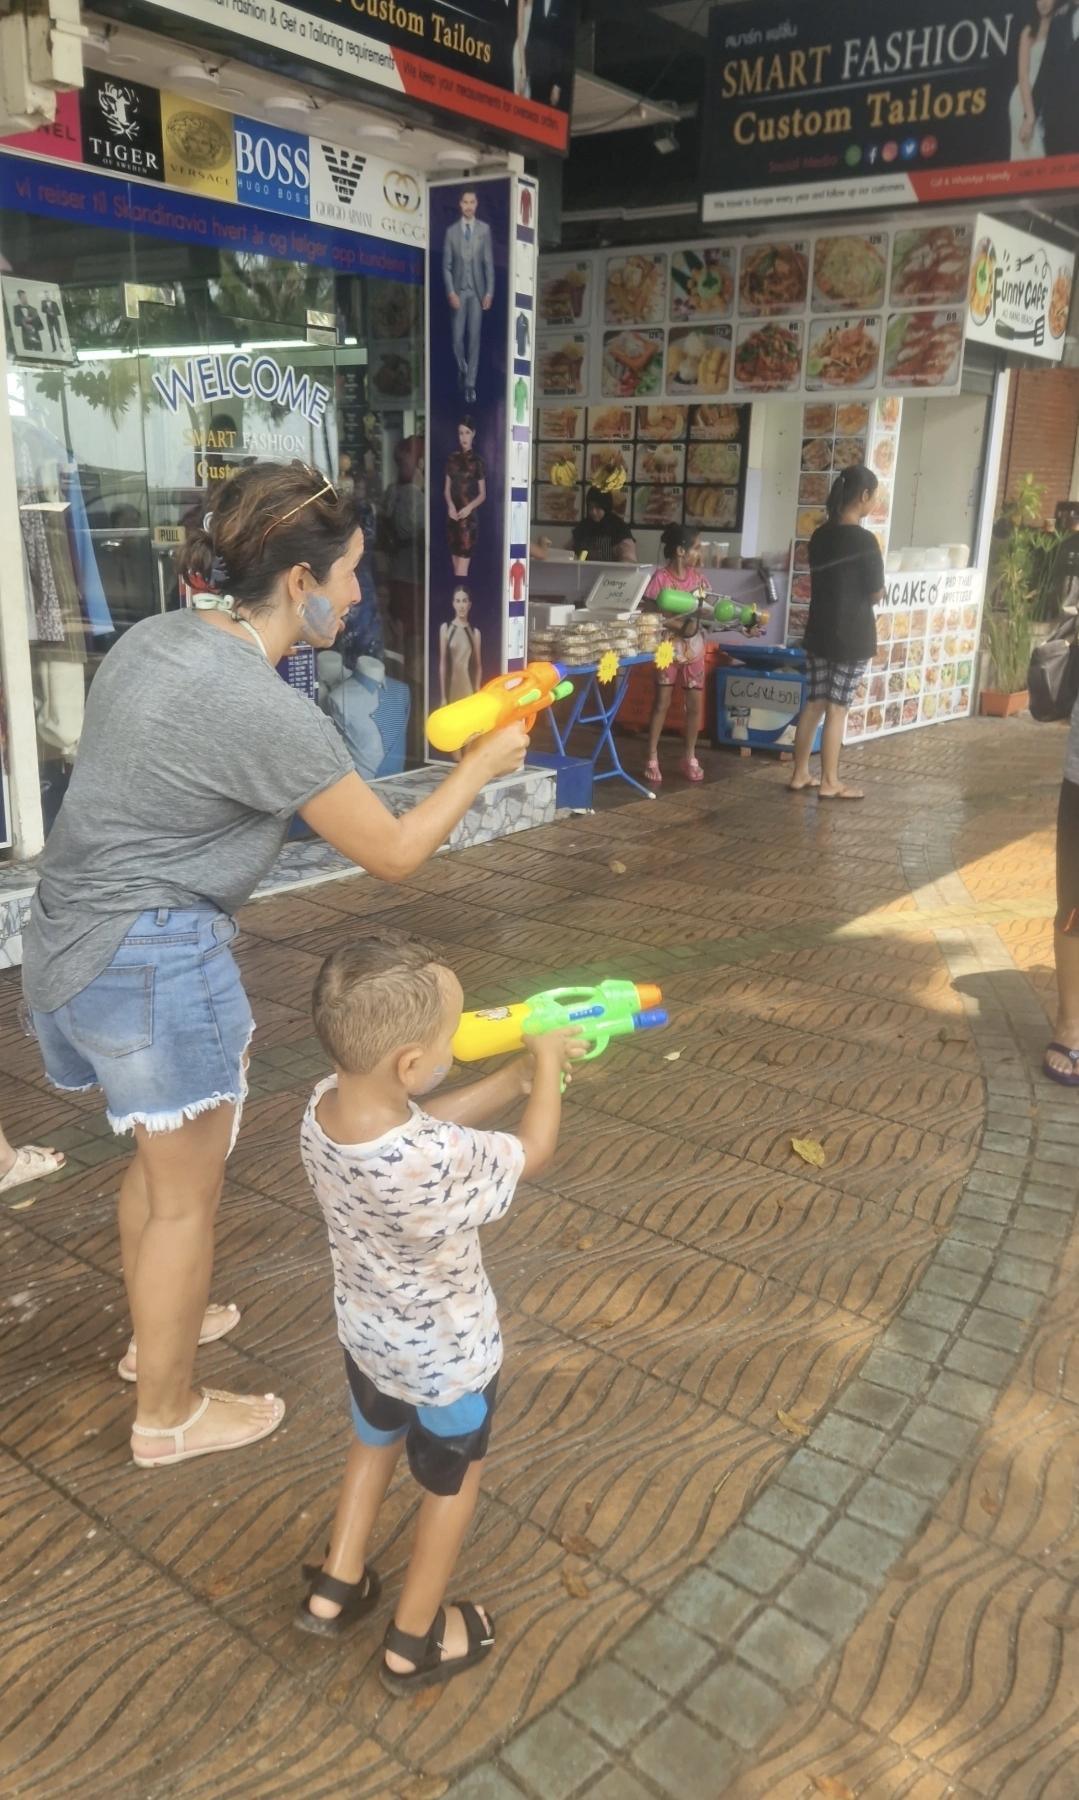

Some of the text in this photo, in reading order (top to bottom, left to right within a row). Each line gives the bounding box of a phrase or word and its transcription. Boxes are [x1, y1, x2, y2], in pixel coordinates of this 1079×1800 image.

[270, 7, 277, 24] &
[280, 11, 297, 33] Get
[300, 26, 305, 37] a
[308, 22, 343, 56] Tailoring
[345, 40, 395, 70] requirements
[432, 13, 492, 63] Tailors
[721, 14, 1014, 98] SMART FASHION
[733, 83, 987, 146] Custom Tailors
[38, 122, 76, 141] NEL
[89, 137, 159, 170] TIGER
[102, 158, 148, 174] OF SWEDEN
[234, 130, 310, 189] BOSS
[170, 164, 231, 186] VERSACE
[237, 179, 309, 205] HUGO BOSS
[16, 176, 31, 198] vi
[38, 182, 86, 210] reiser
[92, 190, 108, 214] til
[113, 194, 207, 234] Skandinavia
[212, 217, 248, 241] hvert
[269, 234, 287, 255] og
[152, 353, 329, 428] WELCOME
[183, 429, 306, 453] SMART FASHION
[160, 529, 180, 542] PULL
[882, 580, 927, 607] NCAKE
